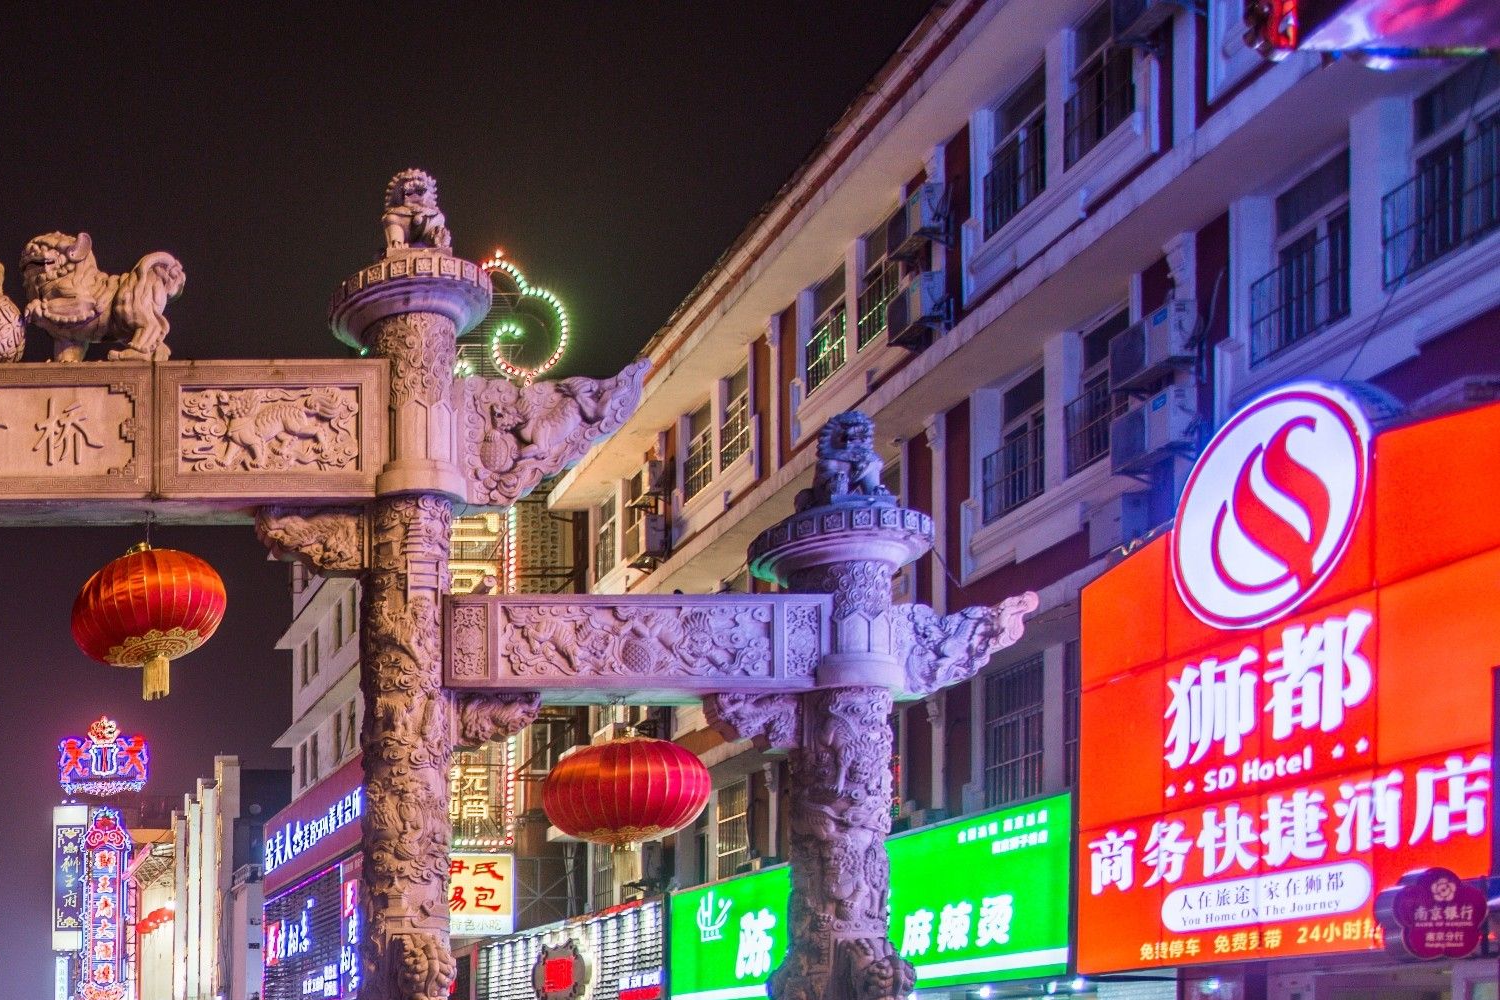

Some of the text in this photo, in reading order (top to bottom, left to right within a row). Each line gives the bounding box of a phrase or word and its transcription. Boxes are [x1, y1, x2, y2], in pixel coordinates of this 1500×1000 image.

[1163, 609, 1374, 771] 狮都
[1203, 744, 1313, 792] SD Hotel
[1087, 752, 1493, 895] 商务快捷酒店
[1180, 871, 1344, 911] 人在旅途 家在狮都
[1181, 898, 1341, 927] You Home ON The Journey
[1414, 904, 1474, 921] 南京银行
[900, 894, 1013, 957] 麻辣烫
[1139, 938, 1201, 961] 免费停车
